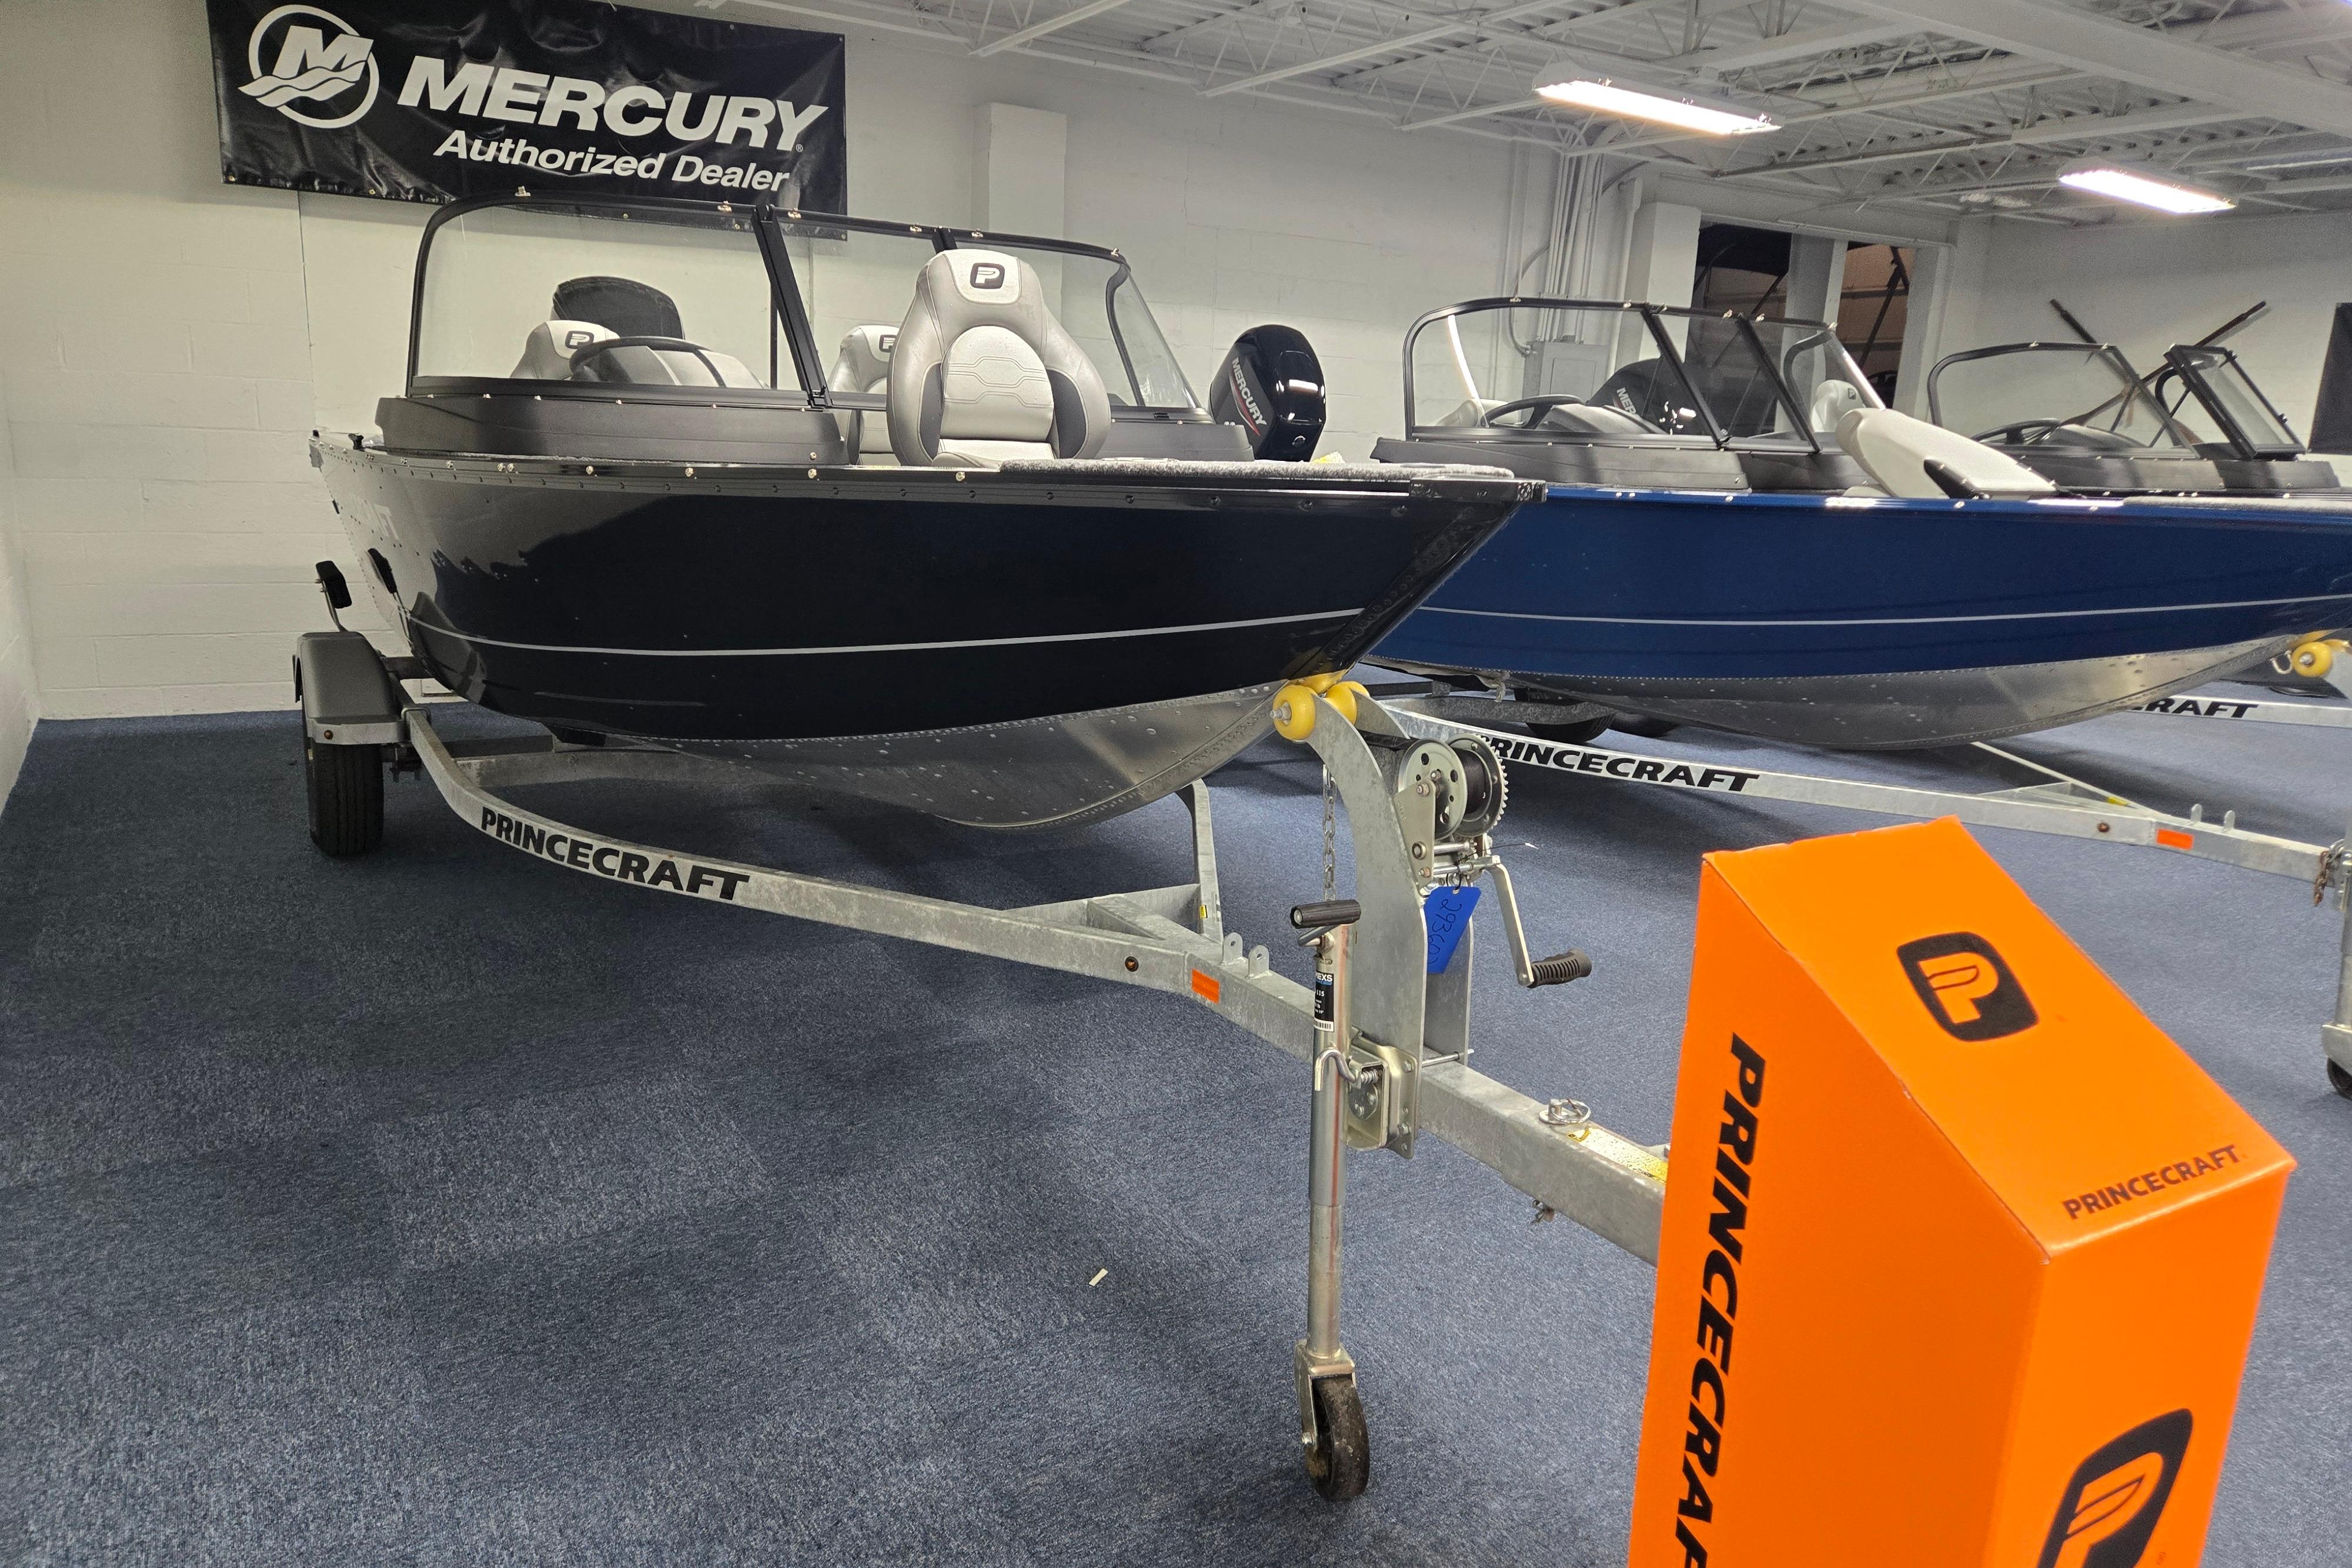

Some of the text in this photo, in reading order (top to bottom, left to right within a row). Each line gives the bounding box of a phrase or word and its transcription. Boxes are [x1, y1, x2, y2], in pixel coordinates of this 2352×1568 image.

[396, 55, 829, 151] MERCURY
[433, 129, 790, 192] Authorized Dealer
[1232, 357, 1267, 426] MERCURY
[2131, 698, 2259, 718] RAFT
[482, 806, 750, 901] PRINCECRAFT
[2062, 1144, 2240, 1221] PRINCECRAFT
